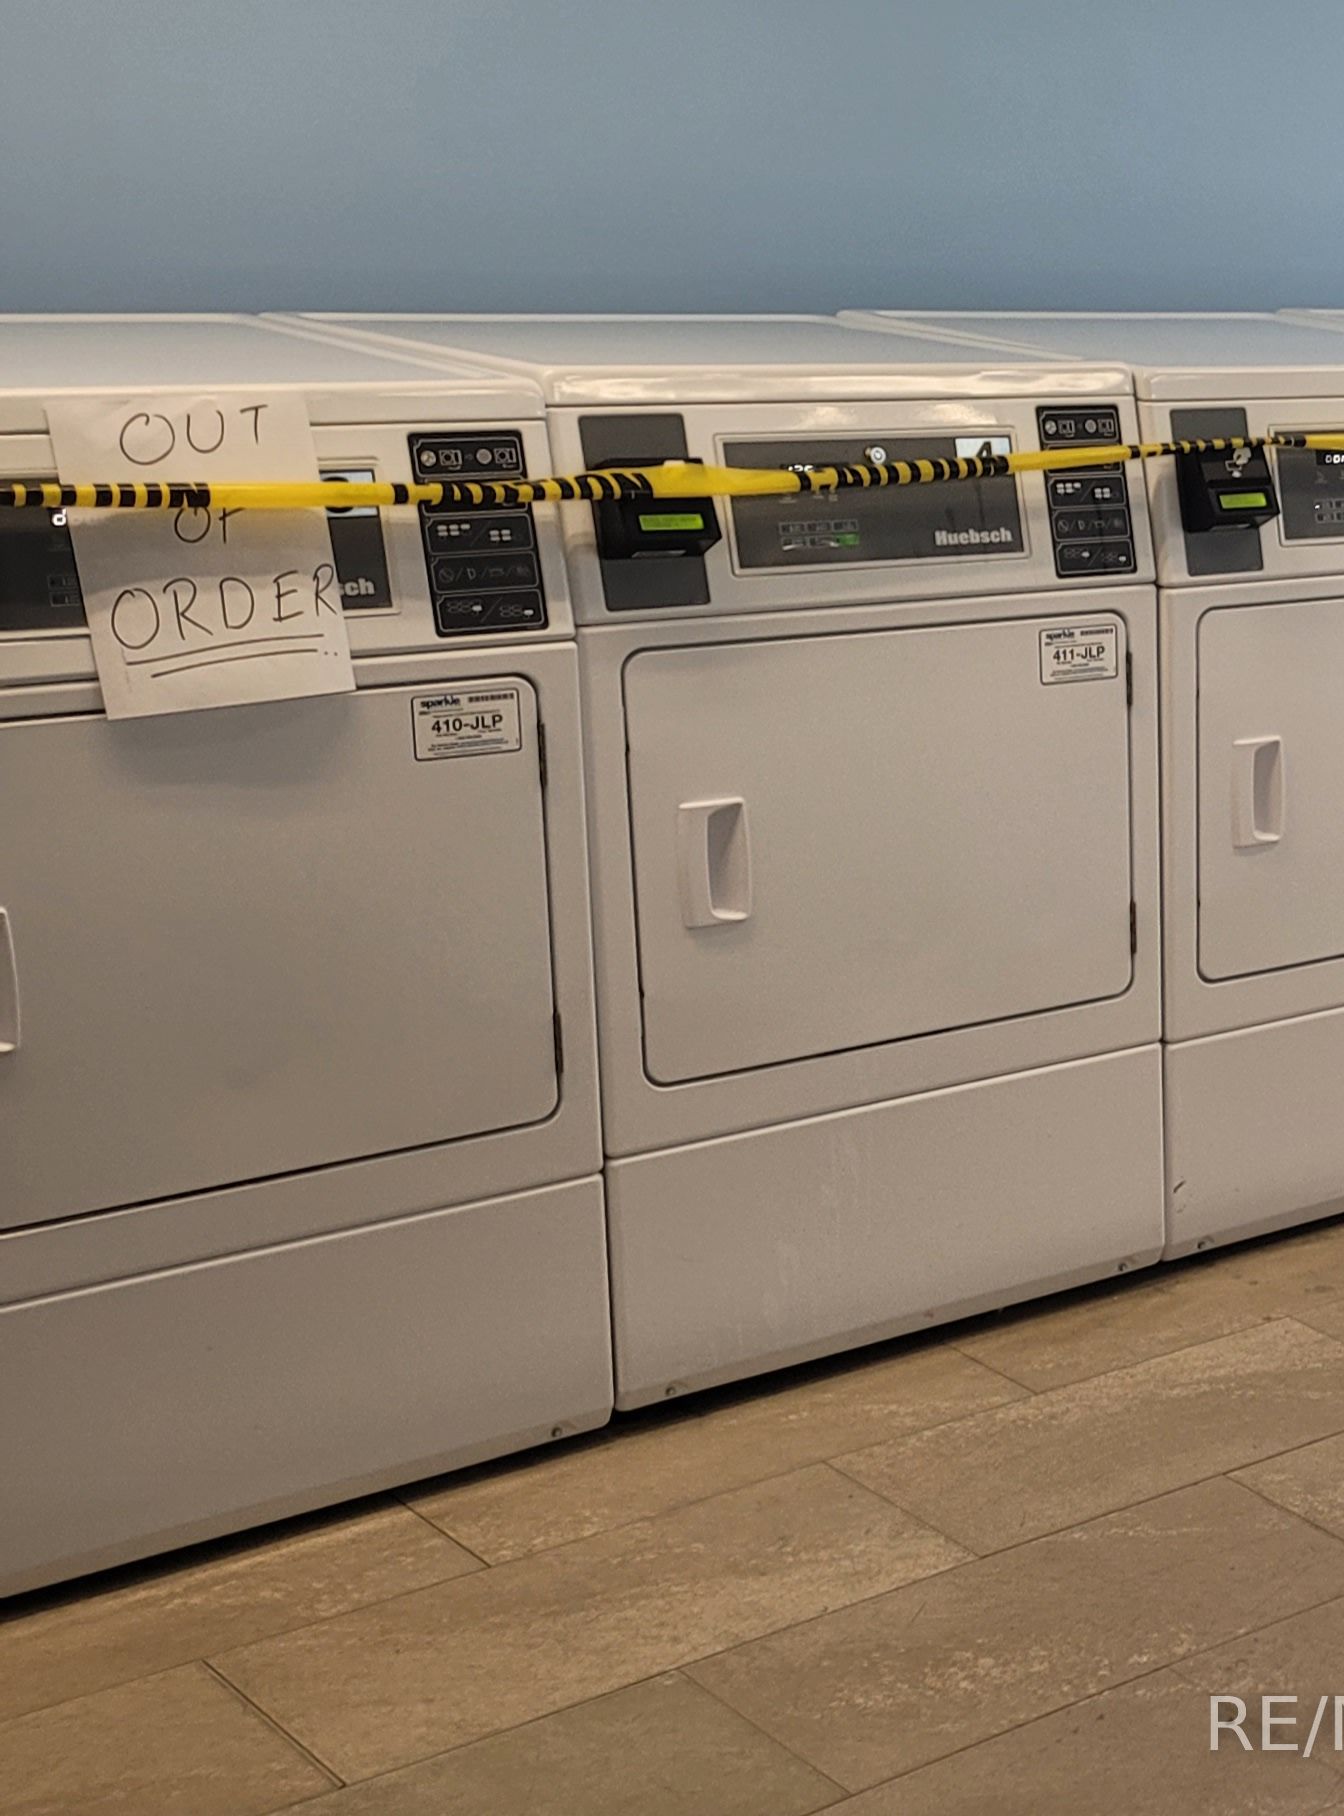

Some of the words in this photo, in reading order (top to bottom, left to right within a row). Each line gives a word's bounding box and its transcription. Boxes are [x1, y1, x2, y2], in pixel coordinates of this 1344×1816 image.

[119, 404, 268, 466] OUT
[934, 527, 1013, 547] Huebsch
[111, 564, 338, 649] ORDER
[1053, 645, 1106, 662] 411-JLP
[431, 714, 503, 733] 410-JLP
